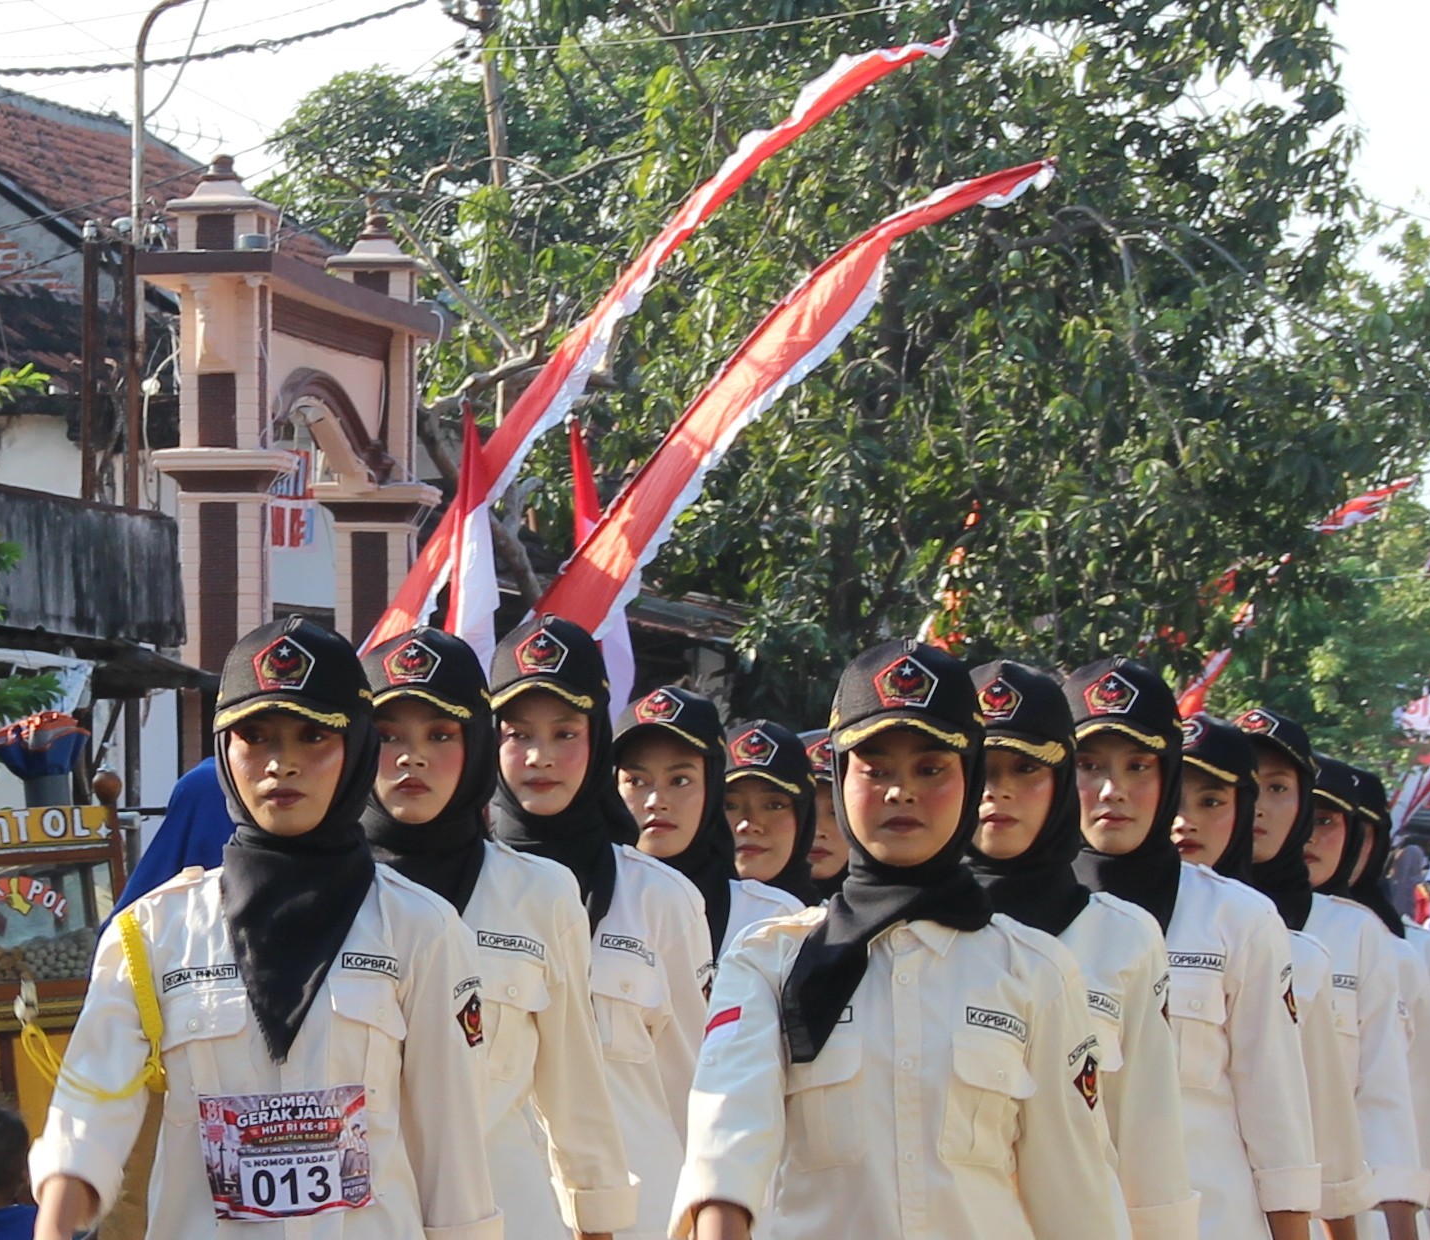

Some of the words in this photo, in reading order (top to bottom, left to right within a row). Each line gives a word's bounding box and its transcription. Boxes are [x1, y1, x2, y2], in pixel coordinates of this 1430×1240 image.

[27, 879, 67, 918] POL
[260, 1095, 319, 1111] LOMBA
[236, 1108, 292, 1128] GERAK
[261, 1123, 285, 1135] HUT
[286, 1122, 297, 1132] RI
[300, 1121, 328, 1131] KE-81
[254, 1157, 293, 1167] NOMOR
[296, 1155, 326, 1165] DADA
[252, 1165, 332, 1207] 013
